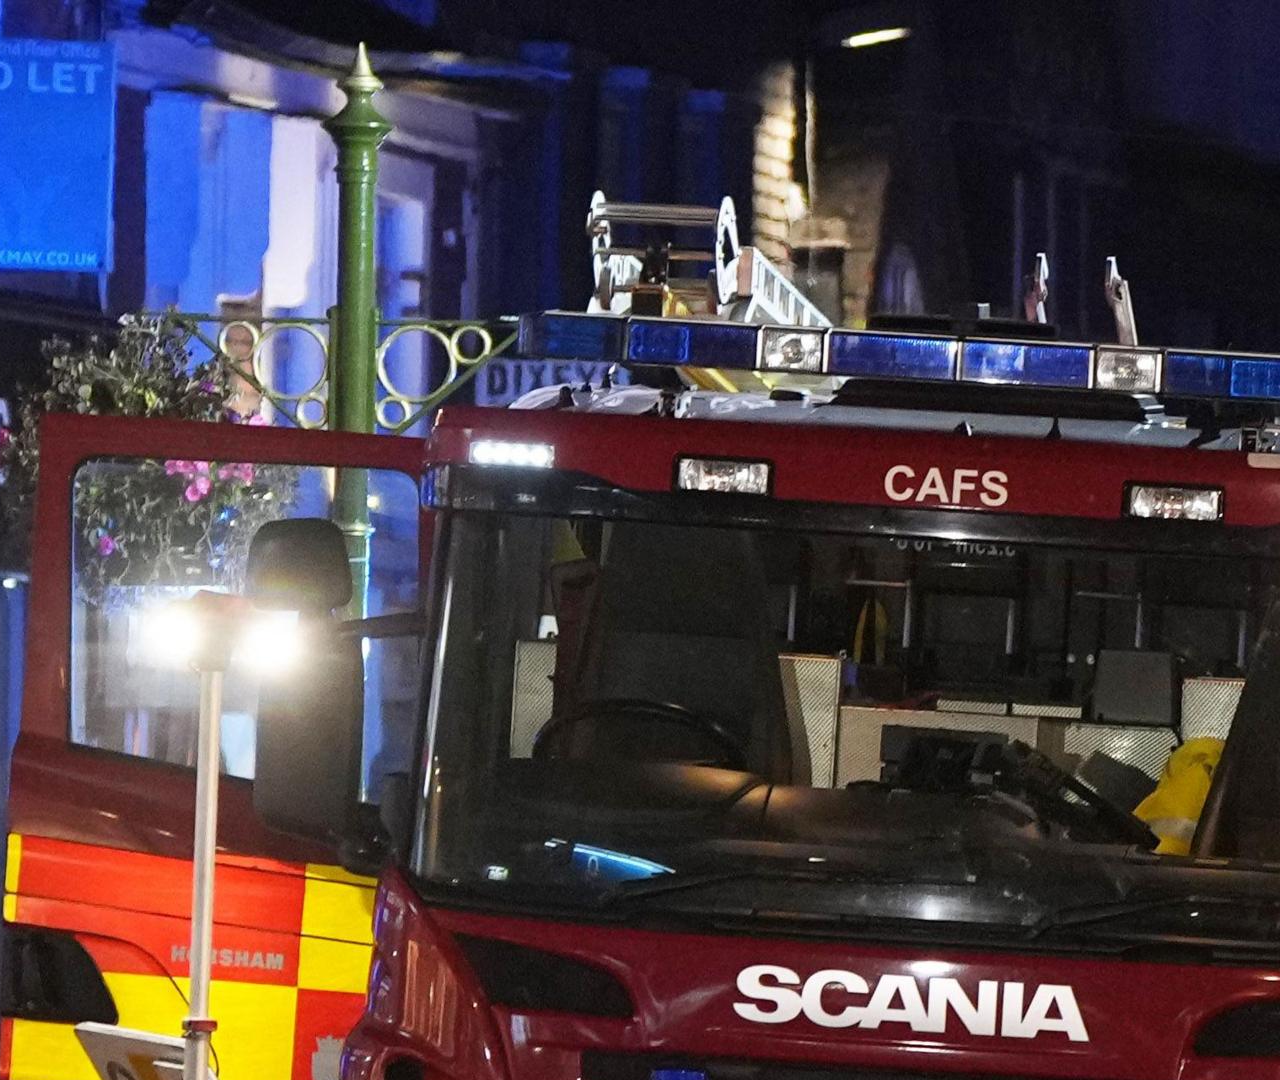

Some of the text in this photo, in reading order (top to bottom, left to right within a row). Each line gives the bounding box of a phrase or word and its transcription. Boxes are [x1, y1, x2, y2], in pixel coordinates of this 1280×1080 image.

[27, 61, 104, 94] LET
[884, 465, 1008, 507] CAFS
[171, 945, 285, 970] HSHAM
[733, 964, 1090, 1042] SCANIA
